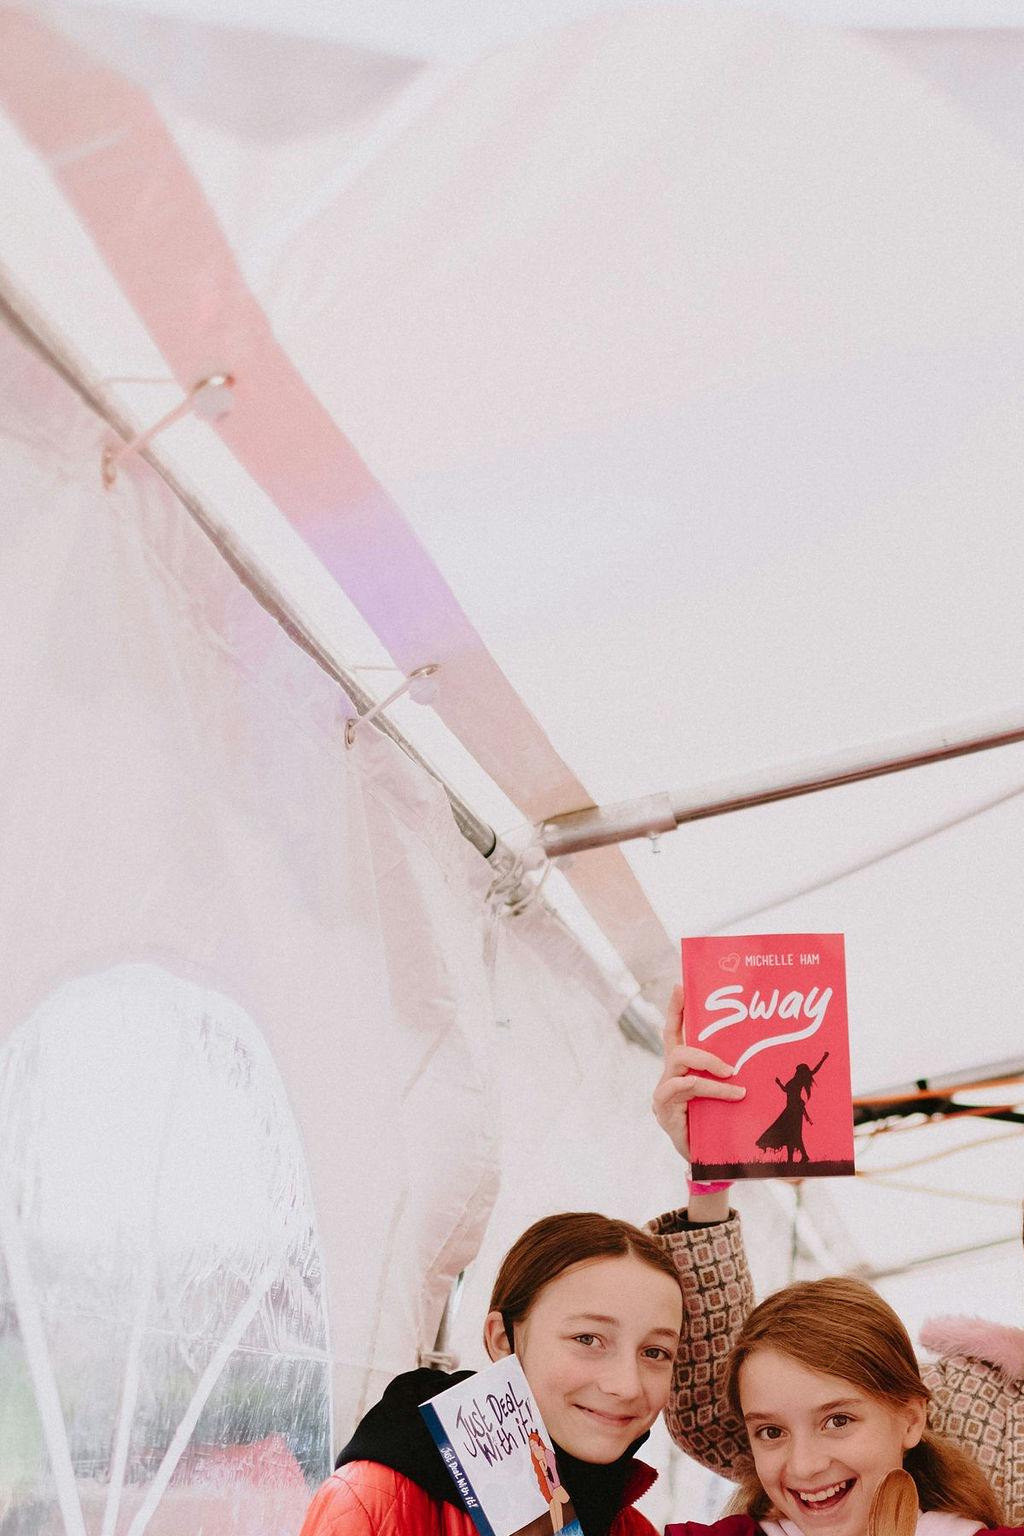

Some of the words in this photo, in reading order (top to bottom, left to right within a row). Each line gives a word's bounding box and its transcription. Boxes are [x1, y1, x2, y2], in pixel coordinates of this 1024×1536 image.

[745, 954, 793, 966] MICHELLE
[800, 954, 820, 964] HAM
[698, 985, 833, 1076] Sway
[456, 1399, 494, 1458] Just
[475, 1427, 519, 1467] With
